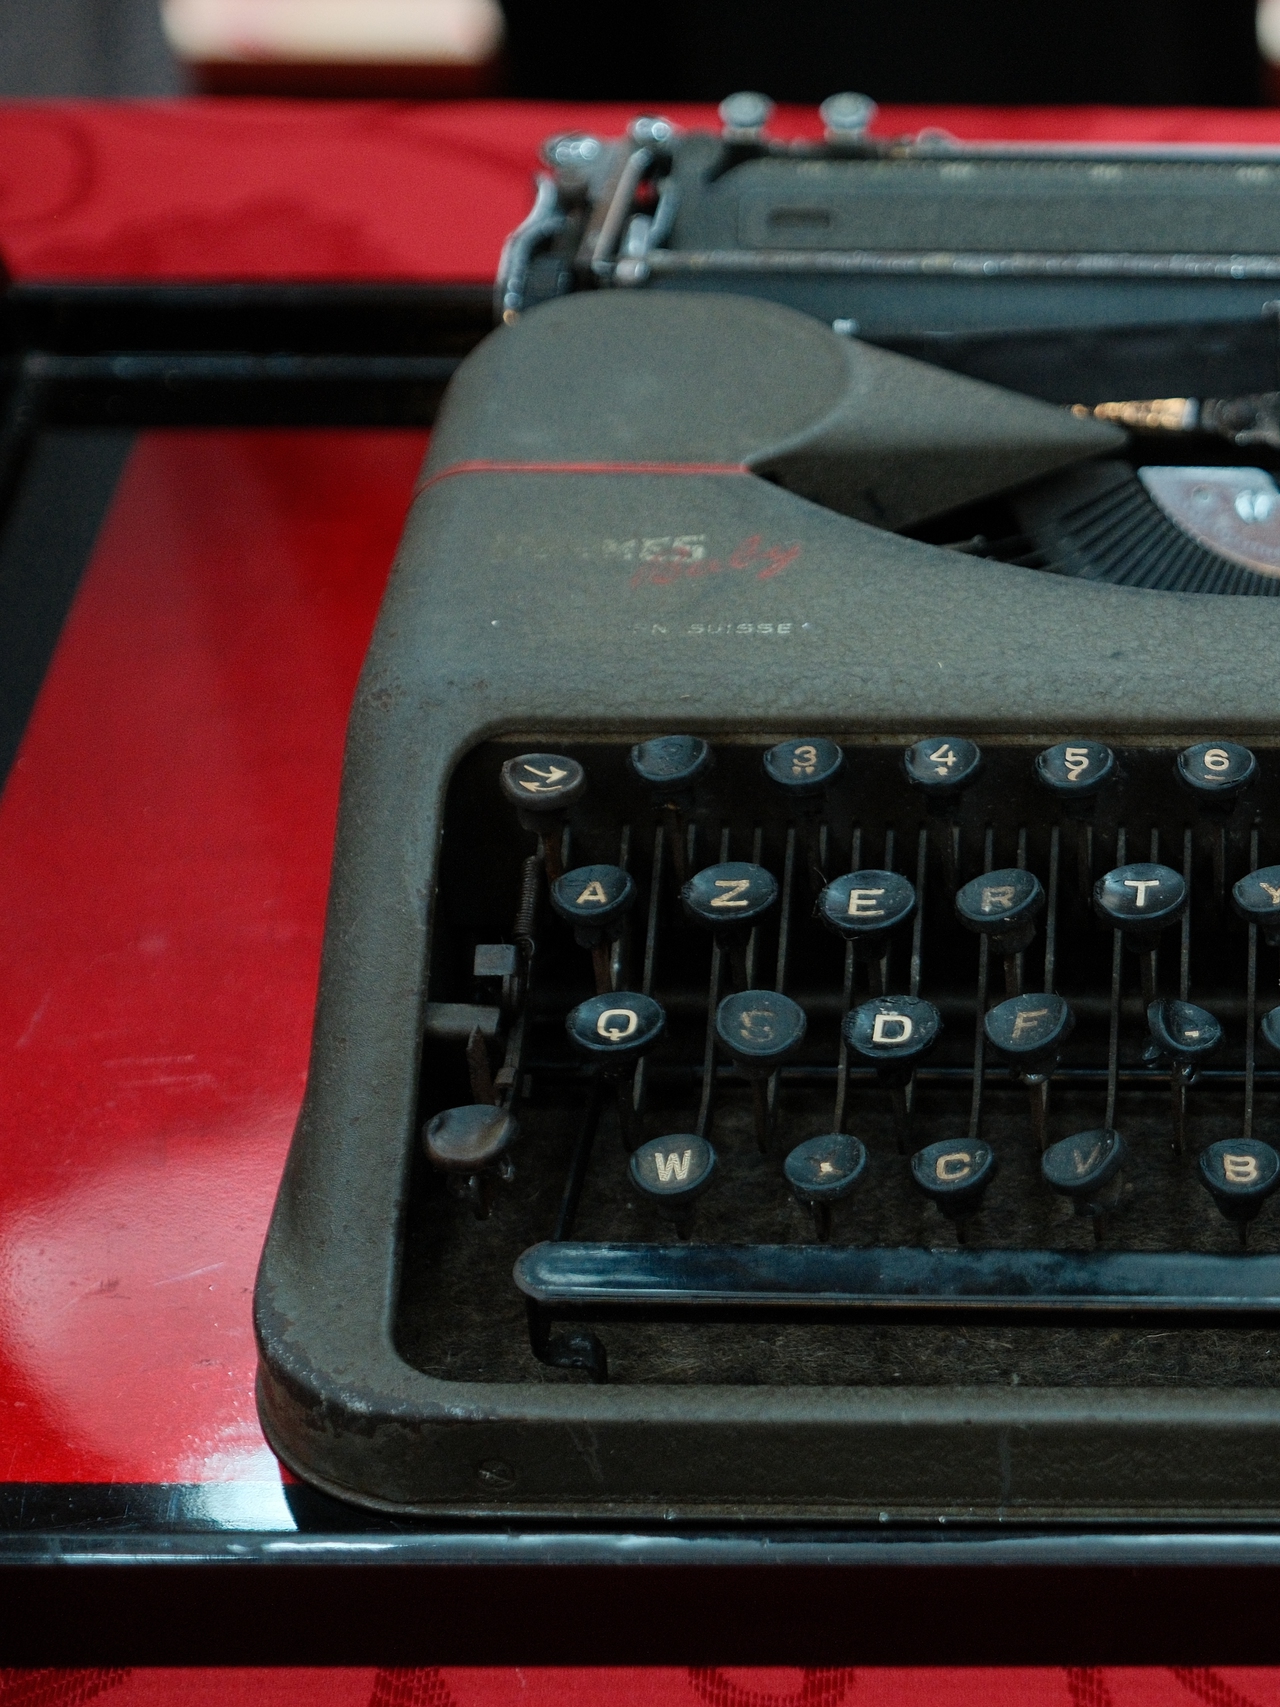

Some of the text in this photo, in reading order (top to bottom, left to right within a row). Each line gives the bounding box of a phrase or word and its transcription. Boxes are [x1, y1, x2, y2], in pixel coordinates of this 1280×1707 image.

[687, 622, 792, 635] SUISSE
[794, 746, 816, 767] 3
[930, 745, 956, 768] 4
[1065, 748, 1088, 768] 5
[1204, 749, 1229, 771] 6
[577, 882, 606, 903] A
[711, 880, 749, 906] Z
[848, 889, 884, 915] E
[982, 886, 1014, 912] R
[1125, 881, 1159, 906] T
[597, 1009, 637, 1041] Q
[741, 1010, 773, 1041] S
[873, 1015, 912, 1042] D
[1012, 1009, 1047, 1038] F
[655, 1150, 691, 1181] W
[936, 1152, 970, 1180] C
[1073, 1146, 1099, 1174] V
[1224, 1155, 1258, 1182] B
